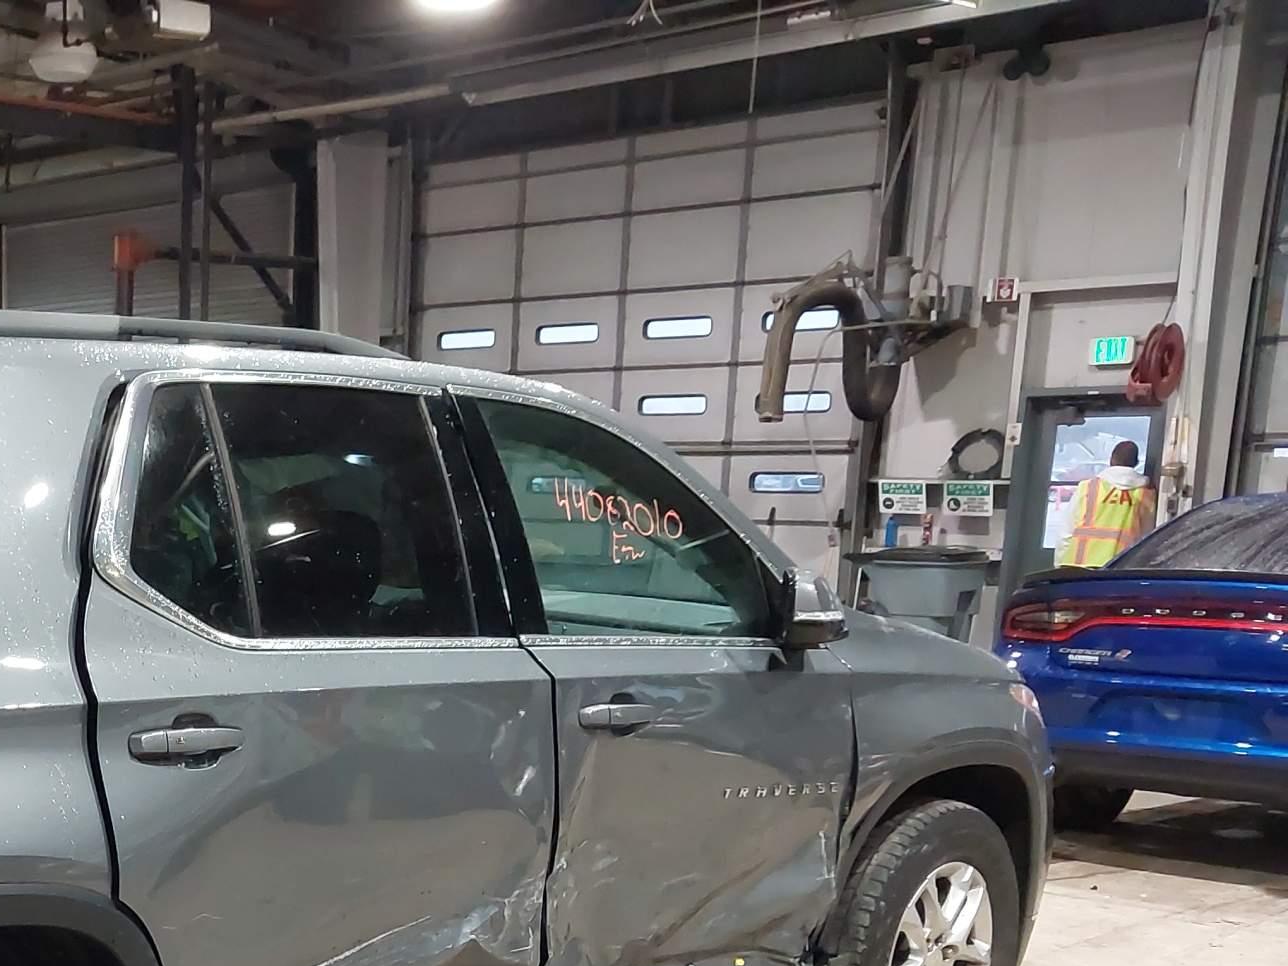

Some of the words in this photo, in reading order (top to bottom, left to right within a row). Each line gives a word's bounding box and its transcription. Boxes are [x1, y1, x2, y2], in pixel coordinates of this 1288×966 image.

[883, 483, 921, 491] SAFETY
[555, 477, 683, 539] 44082010
[723, 782, 838, 799] TRAVERSE
